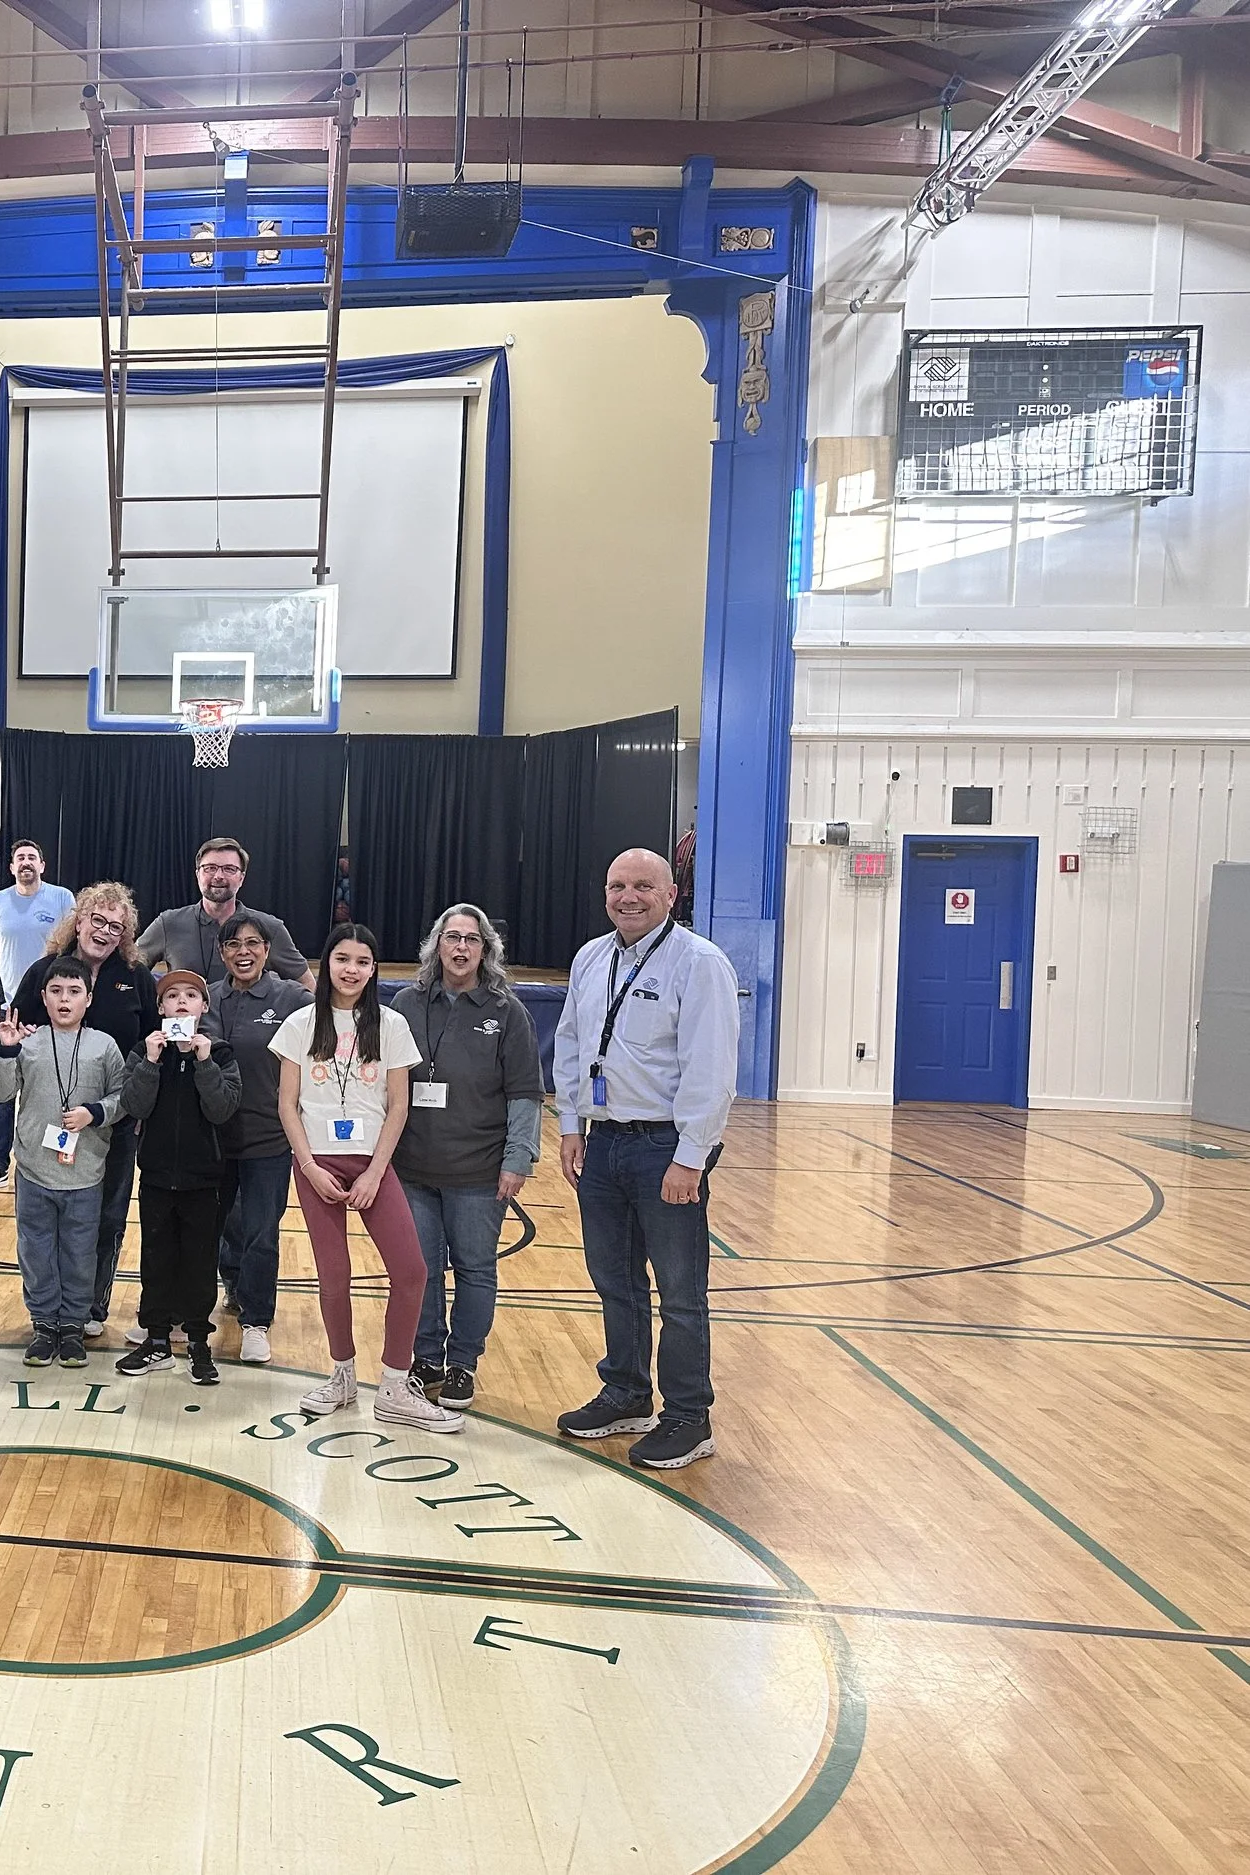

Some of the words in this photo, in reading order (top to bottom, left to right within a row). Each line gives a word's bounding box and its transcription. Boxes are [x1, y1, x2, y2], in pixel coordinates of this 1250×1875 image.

[1126, 349, 1183, 363] PEPSI
[919, 402, 975, 418] HOME
[1017, 403, 1072, 416] PERIOD
[854, 853, 887, 875] EXIT
[240, 1412, 583, 1542] SCOTT
